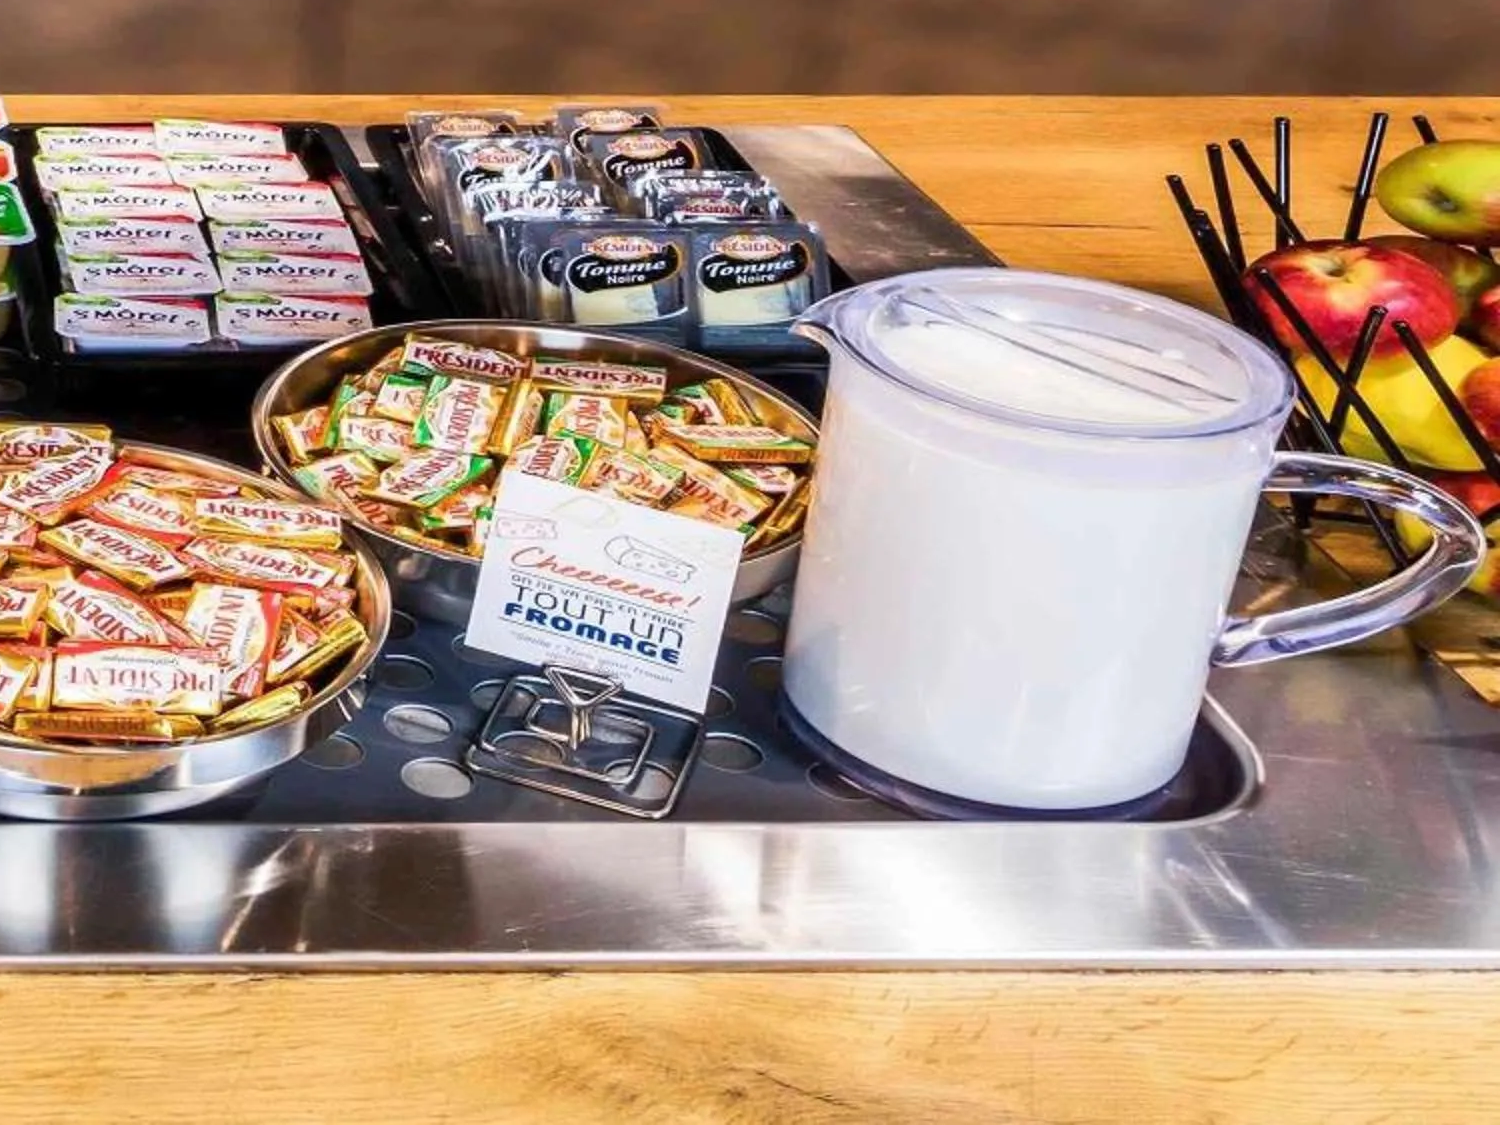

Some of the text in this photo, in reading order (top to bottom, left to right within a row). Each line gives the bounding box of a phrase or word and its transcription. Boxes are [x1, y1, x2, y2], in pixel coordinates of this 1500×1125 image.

[609, 155, 687, 178] Tomme
[575, 261, 667, 278] Tomme
[606, 274, 646, 286] Noire
[705, 261, 796, 278] Tomme
[736, 273, 777, 286] Noire
[7, 454, 101, 503] PRÉSIDENT
[203, 502, 340, 529] PRÉSIDENT
[68, 522, 175, 573] PRÉSIDENT
[194, 537, 324, 580] PRÉSIDENT
[511, 574, 532, 586] ON
[510, 582, 684, 649] TOUT UN
[503, 601, 682, 665] FROMAGE
